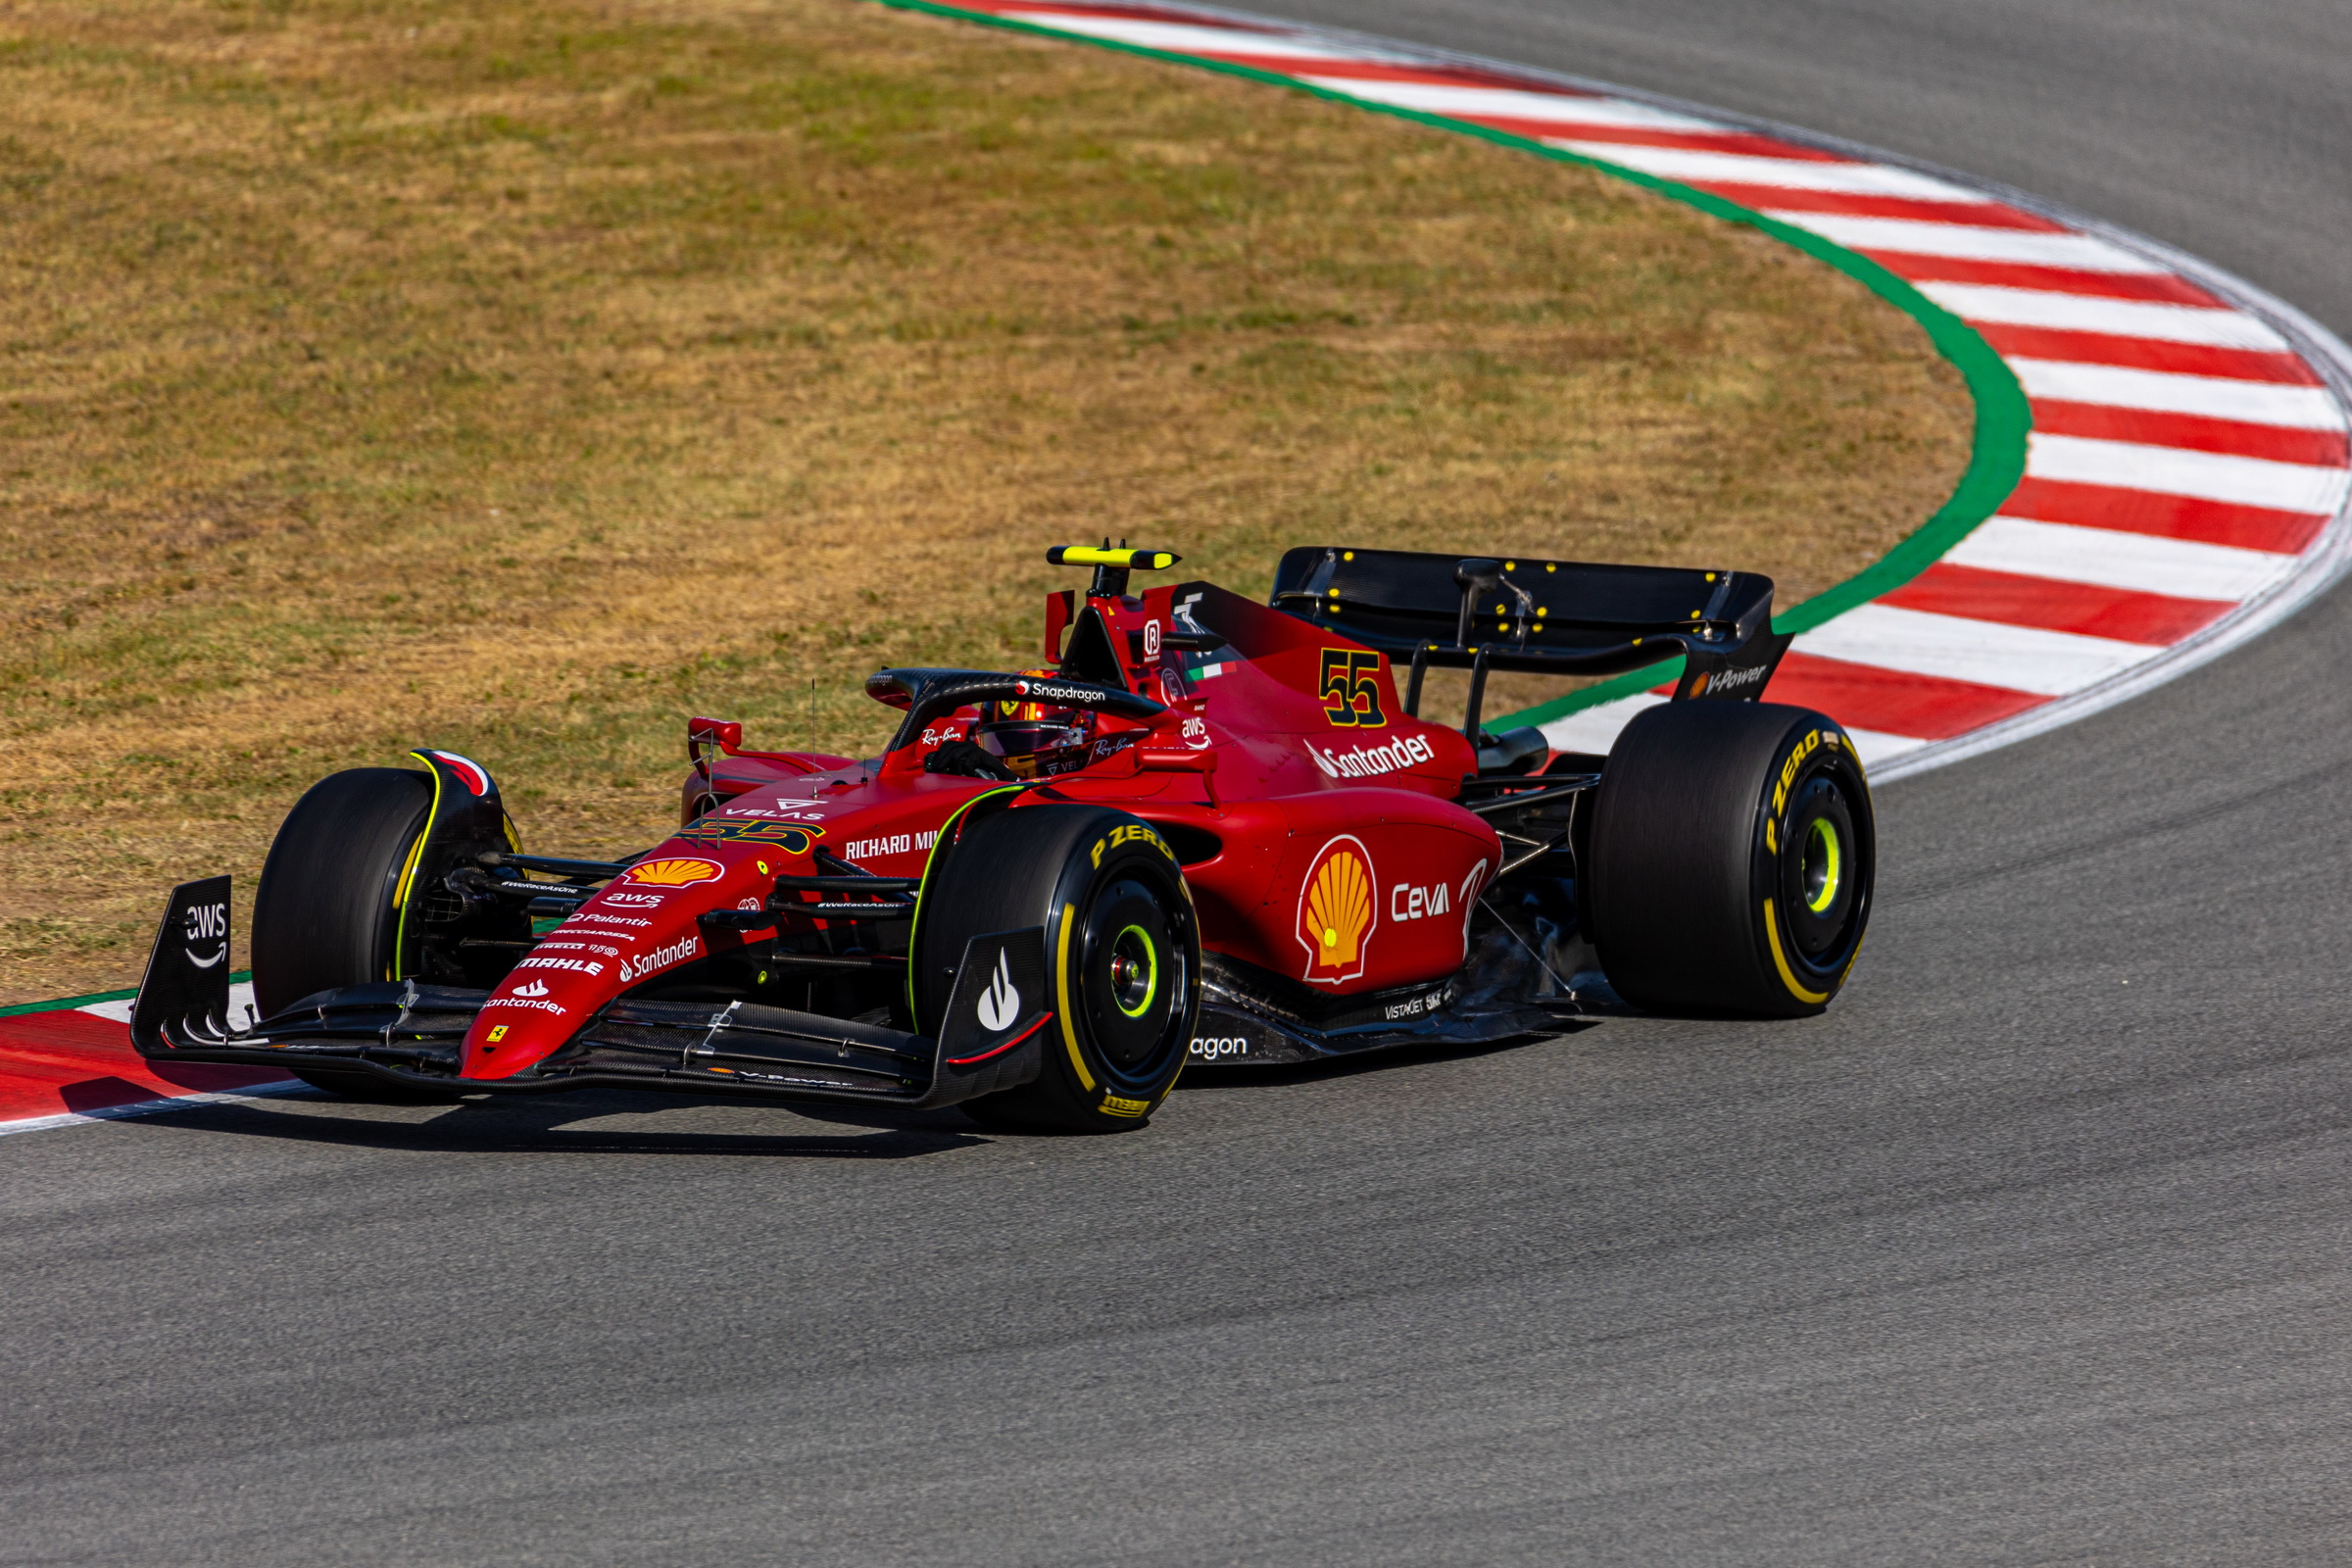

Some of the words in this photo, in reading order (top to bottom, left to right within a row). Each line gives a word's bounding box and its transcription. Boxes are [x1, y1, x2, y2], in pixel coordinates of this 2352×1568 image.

[1318, 647, 1387, 728] 55
[1706, 664, 1767, 695] V-Power
[1033, 683, 1105, 702] Snapdragon
[1182, 716, 1205, 738] aws
[1061, 759, 1085, 772] VELA
[1331, 733, 1436, 778] Santander
[1766, 817, 1777, 857] P
[1772, 728, 1820, 817] ZERO
[725, 808, 825, 821] VELAS
[671, 817, 826, 855] 55
[846, 834, 909, 859] RICHARD
[1090, 838, 1105, 870] P
[1109, 824, 1175, 861] ZERO
[502, 880, 578, 894] #WeRaceAsOne
[607, 893, 664, 904] aws
[187, 903, 225, 940] aws
[583, 913, 652, 927] Palantir
[514, 957, 605, 976] MAHLE
[633, 936, 699, 977] Santander
[1190, 1037, 1248, 1059] agon
